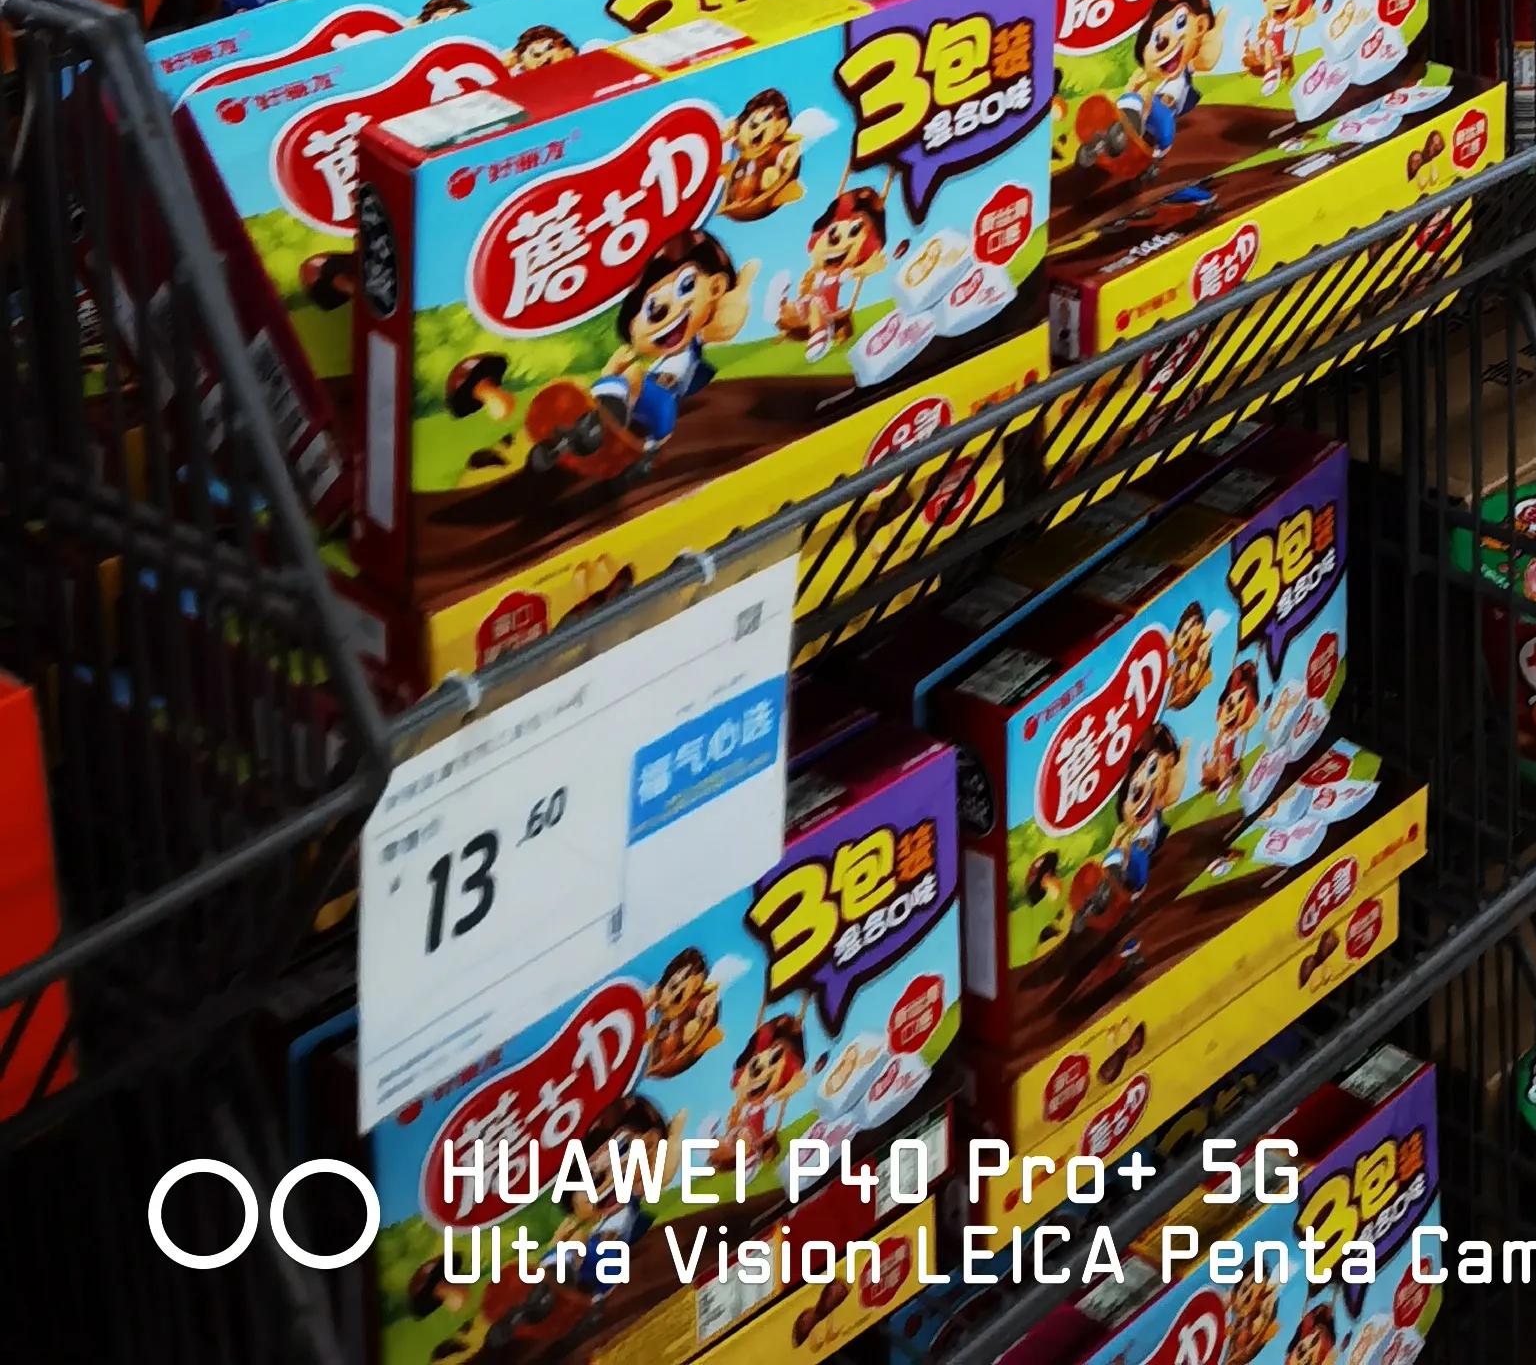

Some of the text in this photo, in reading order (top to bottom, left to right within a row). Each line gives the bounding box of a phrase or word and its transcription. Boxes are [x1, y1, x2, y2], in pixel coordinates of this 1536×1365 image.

[502, 129, 712, 321] 蘑古力
[1055, 657, 1163, 825] 蘑古力
[425, 830, 500, 956] 13
